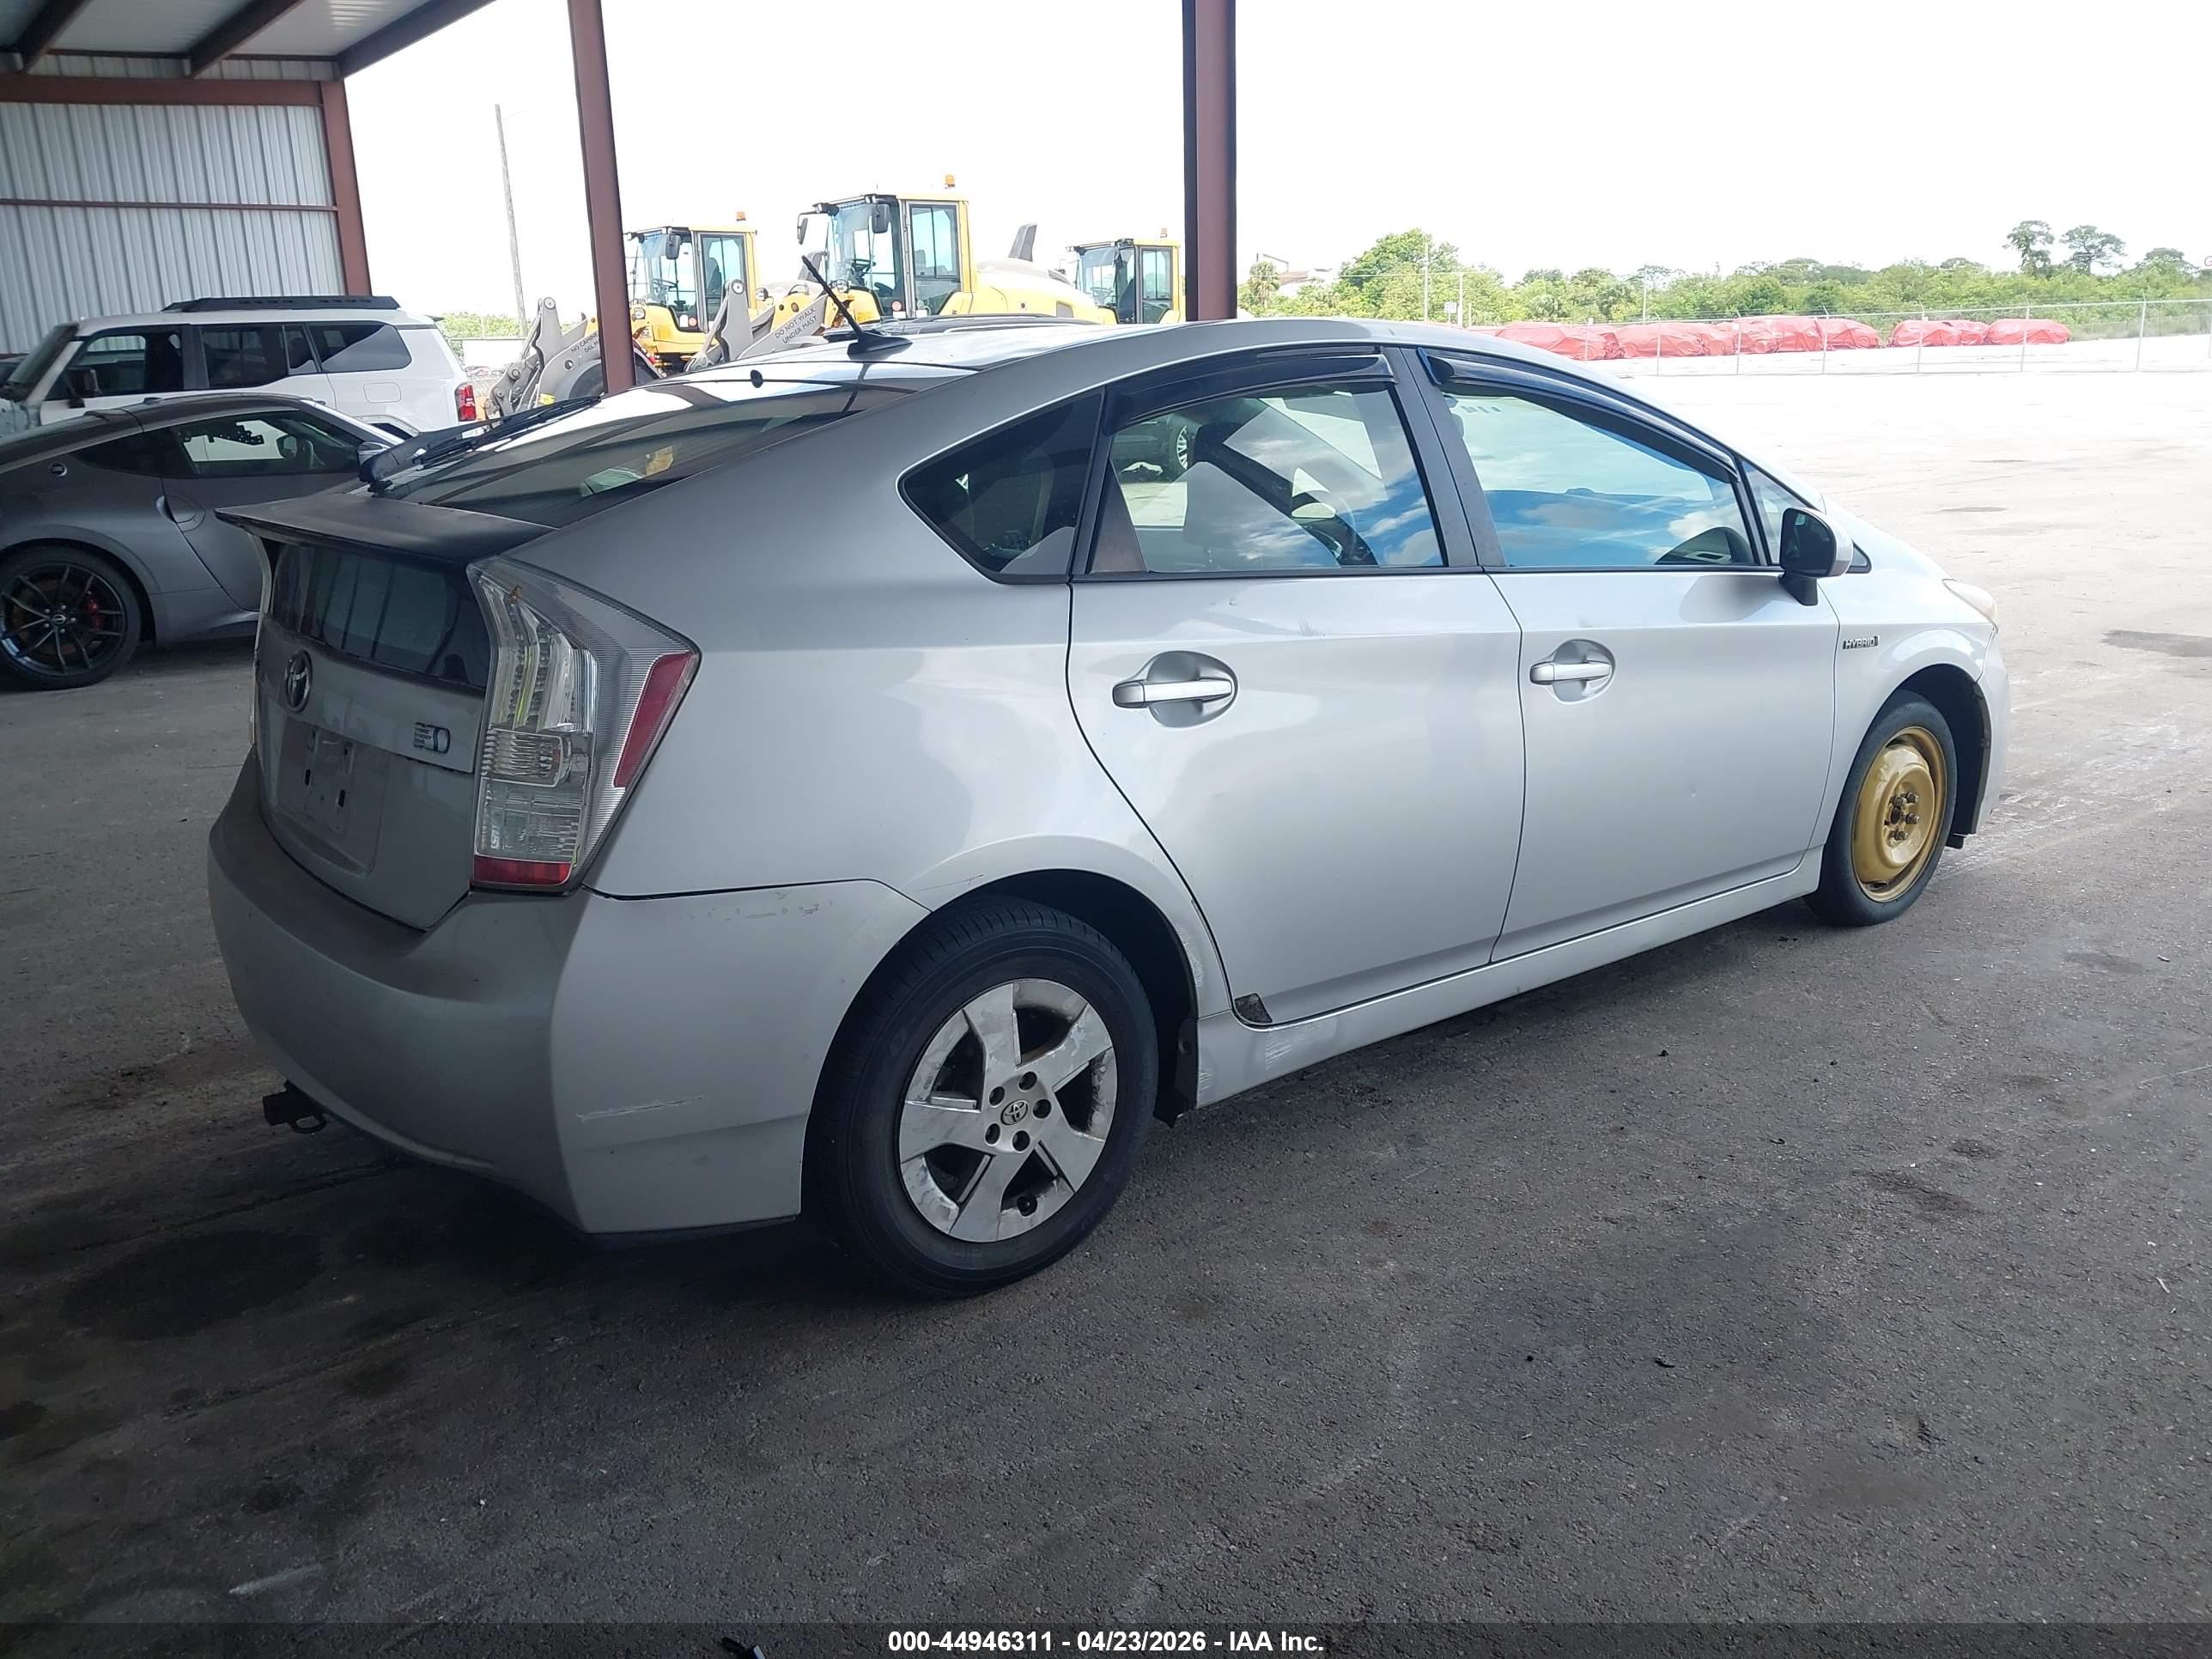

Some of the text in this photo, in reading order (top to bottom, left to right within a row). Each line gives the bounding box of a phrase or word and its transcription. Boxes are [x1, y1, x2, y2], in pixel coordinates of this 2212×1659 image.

[775, 307, 816, 338] DO NOT WALK
[782, 315, 817, 343] UNDER MAST
[1844, 636, 1877, 649] HYBRID
